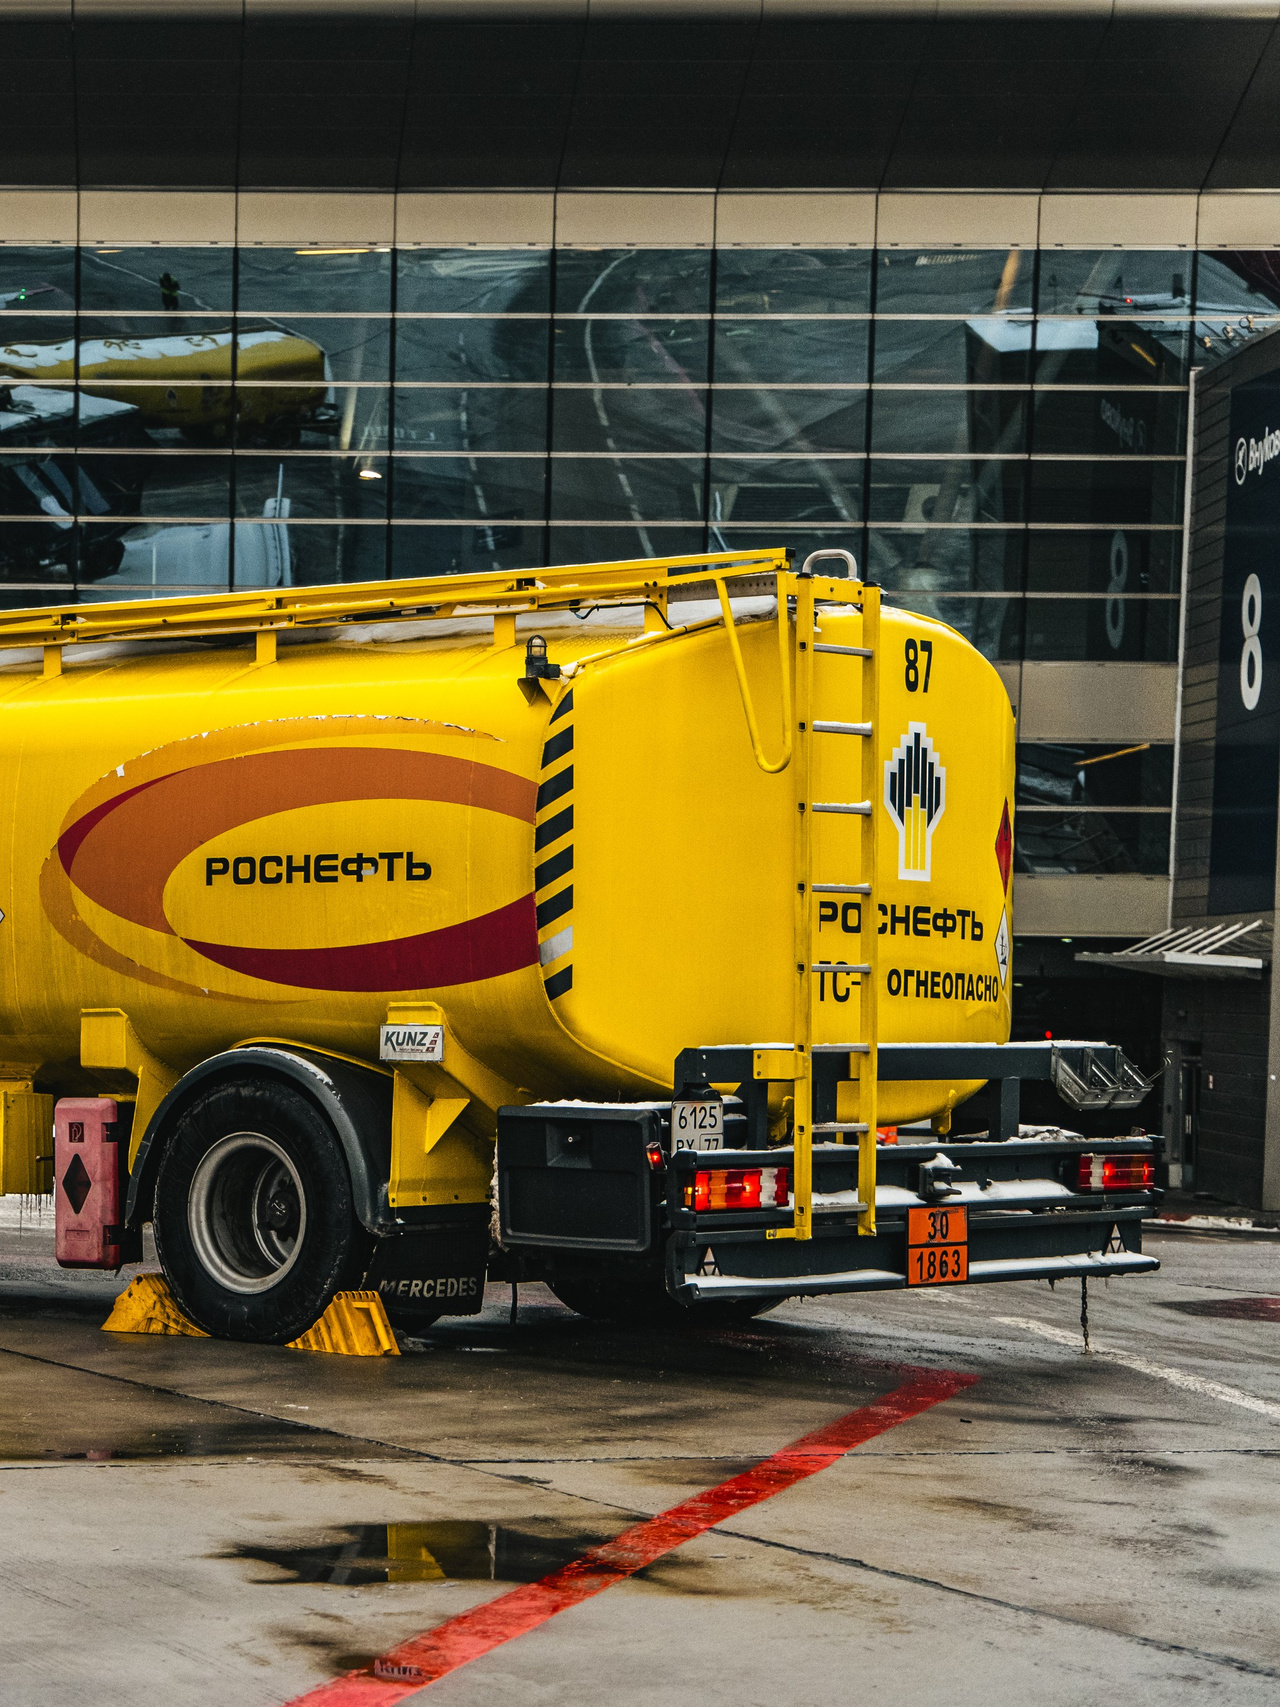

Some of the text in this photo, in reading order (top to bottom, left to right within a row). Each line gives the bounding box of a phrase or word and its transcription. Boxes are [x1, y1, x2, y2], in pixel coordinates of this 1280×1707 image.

[1241, 573, 1262, 710] 8
[905, 638, 933, 693] 87
[206, 851, 432, 886] РОСНЕФТЬ
[887, 969, 999, 1003] ОГНЕОПАСНО
[384, 1031, 428, 1052] KUNZ
[679, 1106, 717, 1129] 6125
[928, 1211, 949, 1240] 30
[917, 1250, 960, 1279] 1863
[379, 1277, 477, 1298] MERCEDES
